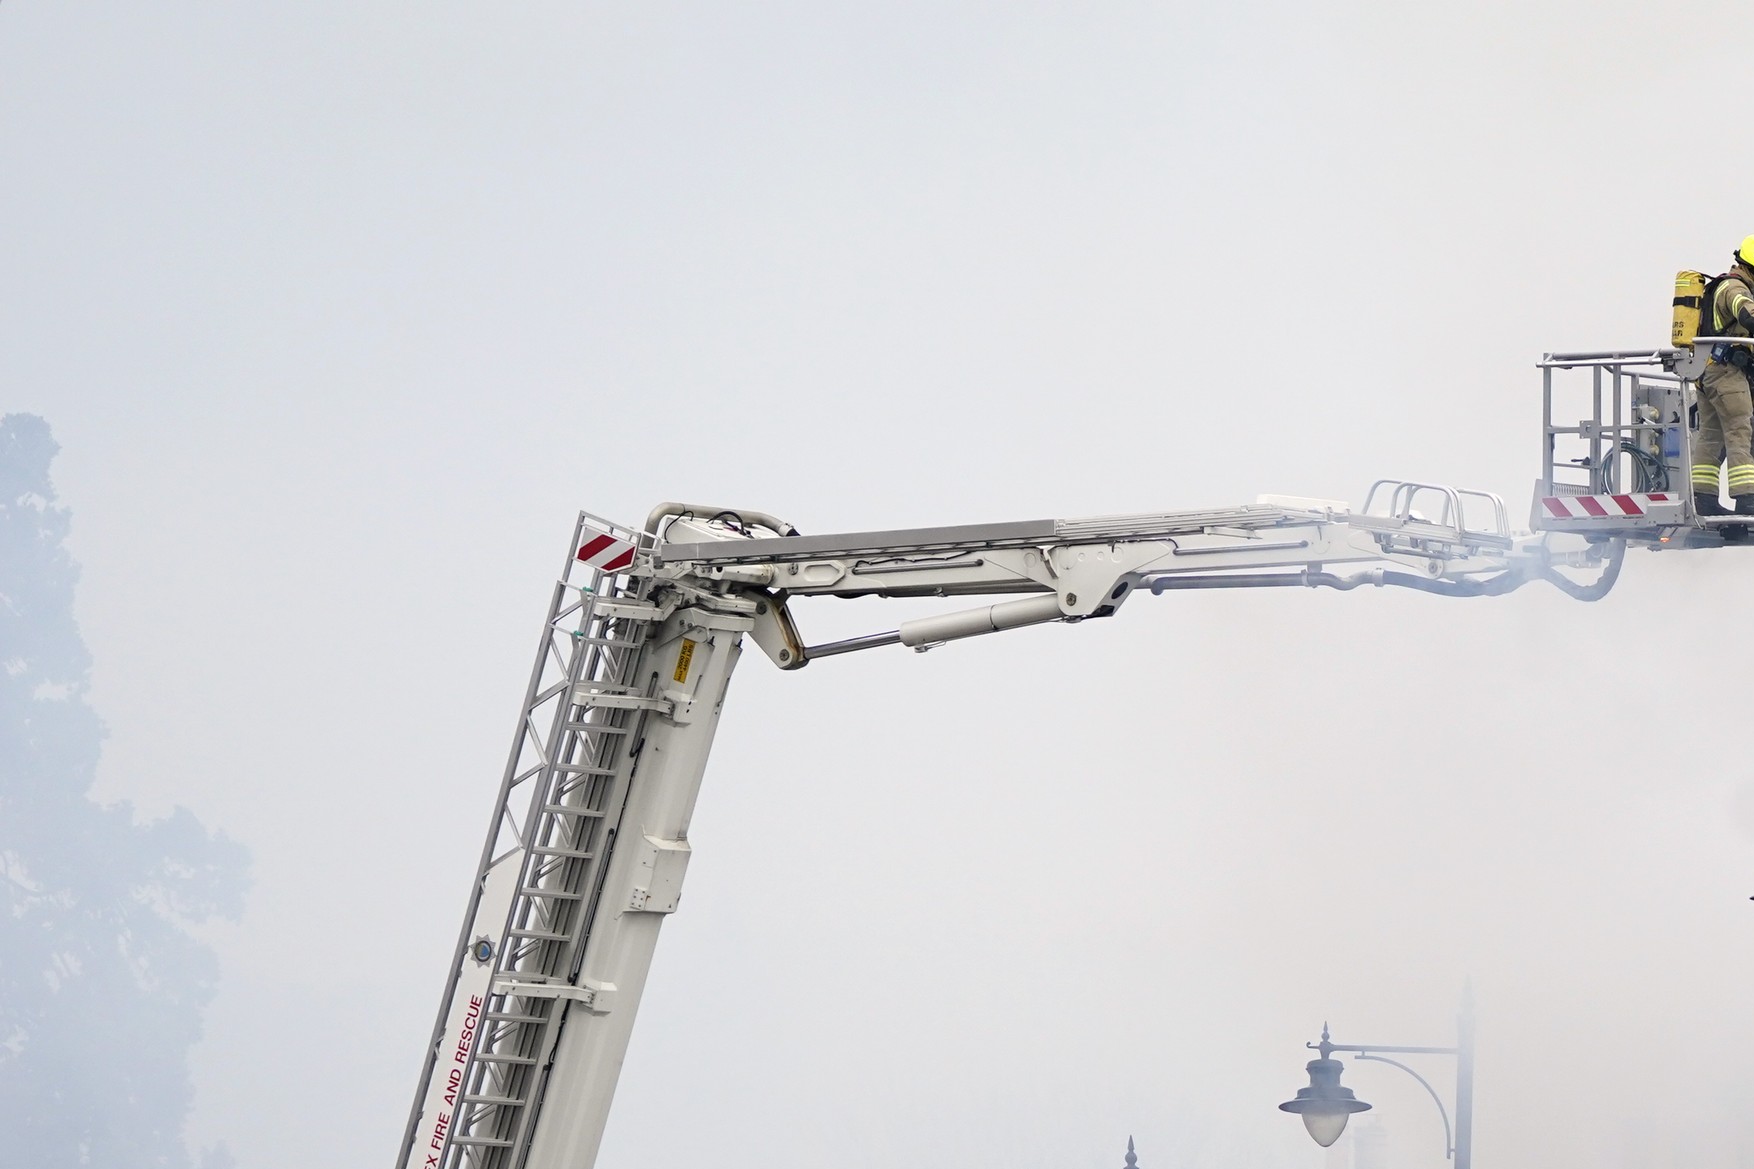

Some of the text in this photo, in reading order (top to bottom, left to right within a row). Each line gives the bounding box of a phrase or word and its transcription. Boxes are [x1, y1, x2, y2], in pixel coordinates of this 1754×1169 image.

[430, 1111, 451, 1151] FIRE
[444, 1068, 462, 1107] AND
[454, 994, 483, 1064] RESCUE
